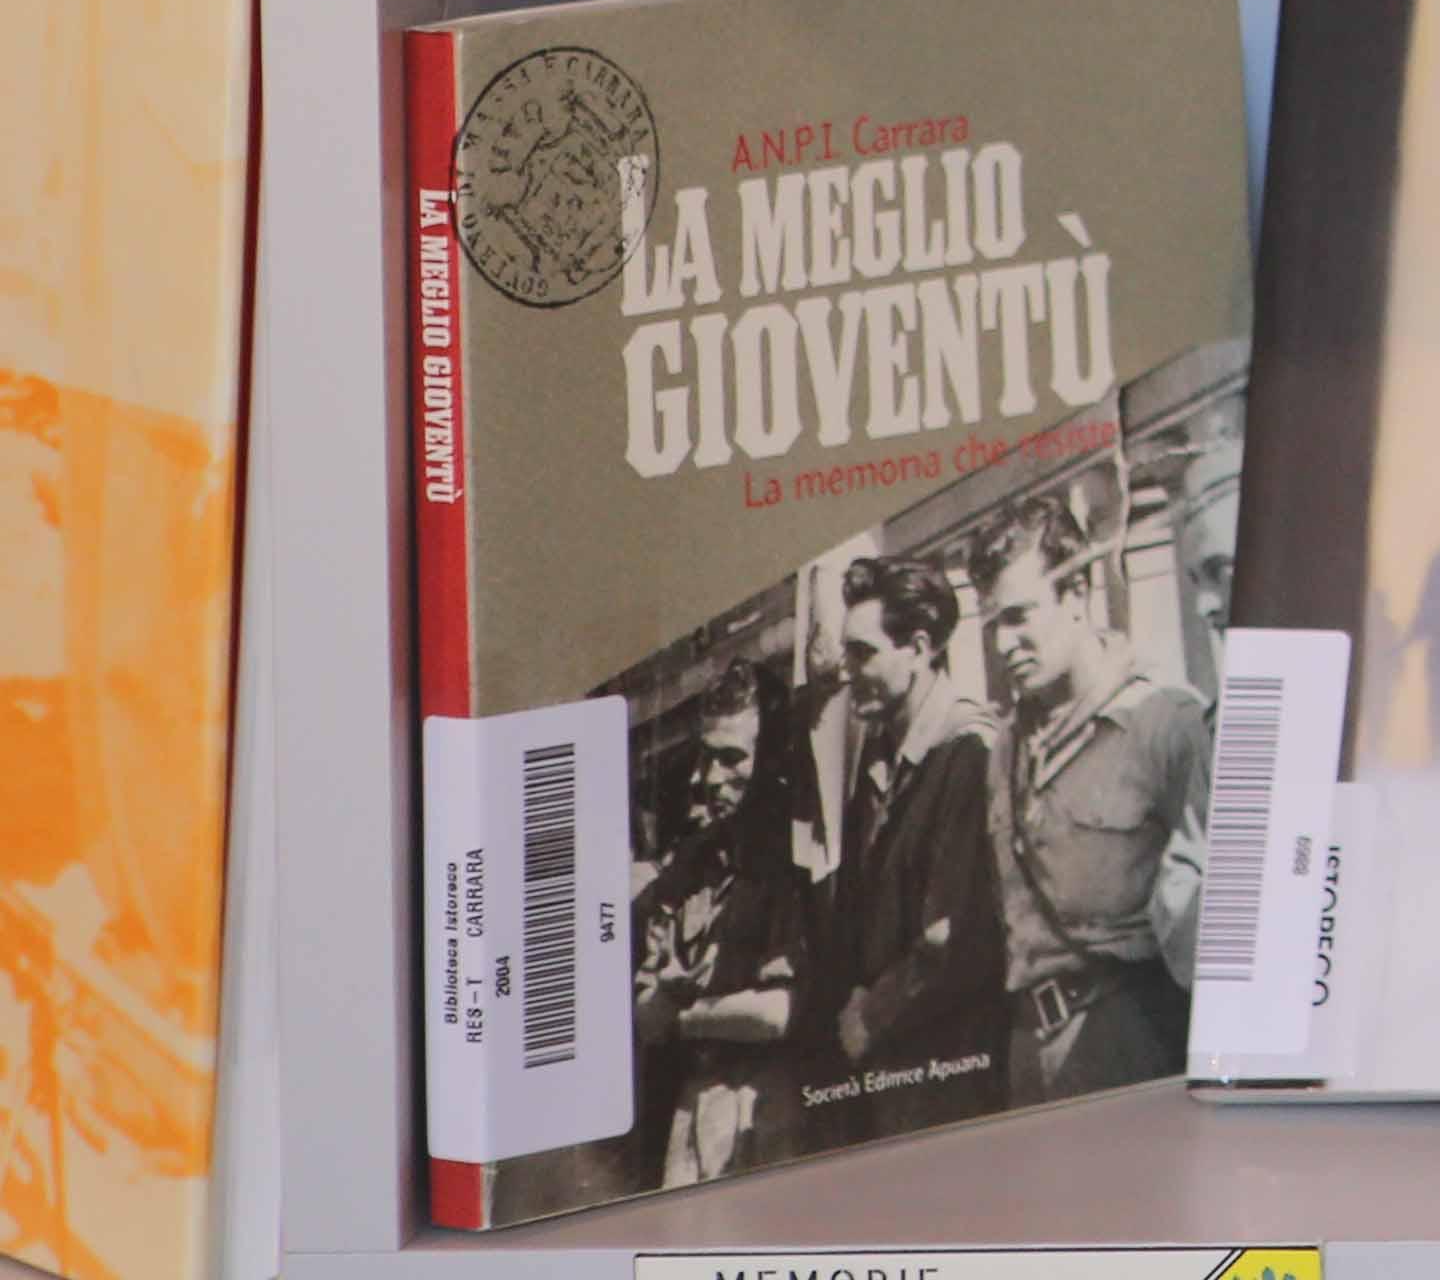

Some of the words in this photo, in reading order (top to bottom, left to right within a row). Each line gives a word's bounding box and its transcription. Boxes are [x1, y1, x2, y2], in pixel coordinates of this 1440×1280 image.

[732, 134, 841, 173] A.N.P.I.
[851, 112, 969, 156] Carrara
[619, 154, 720, 317] LA
[737, 141, 1024, 294] MEGLIO
[621, 214, 1117, 481] GIOVENTÙ
[466, 848, 484, 938] CARRARA
